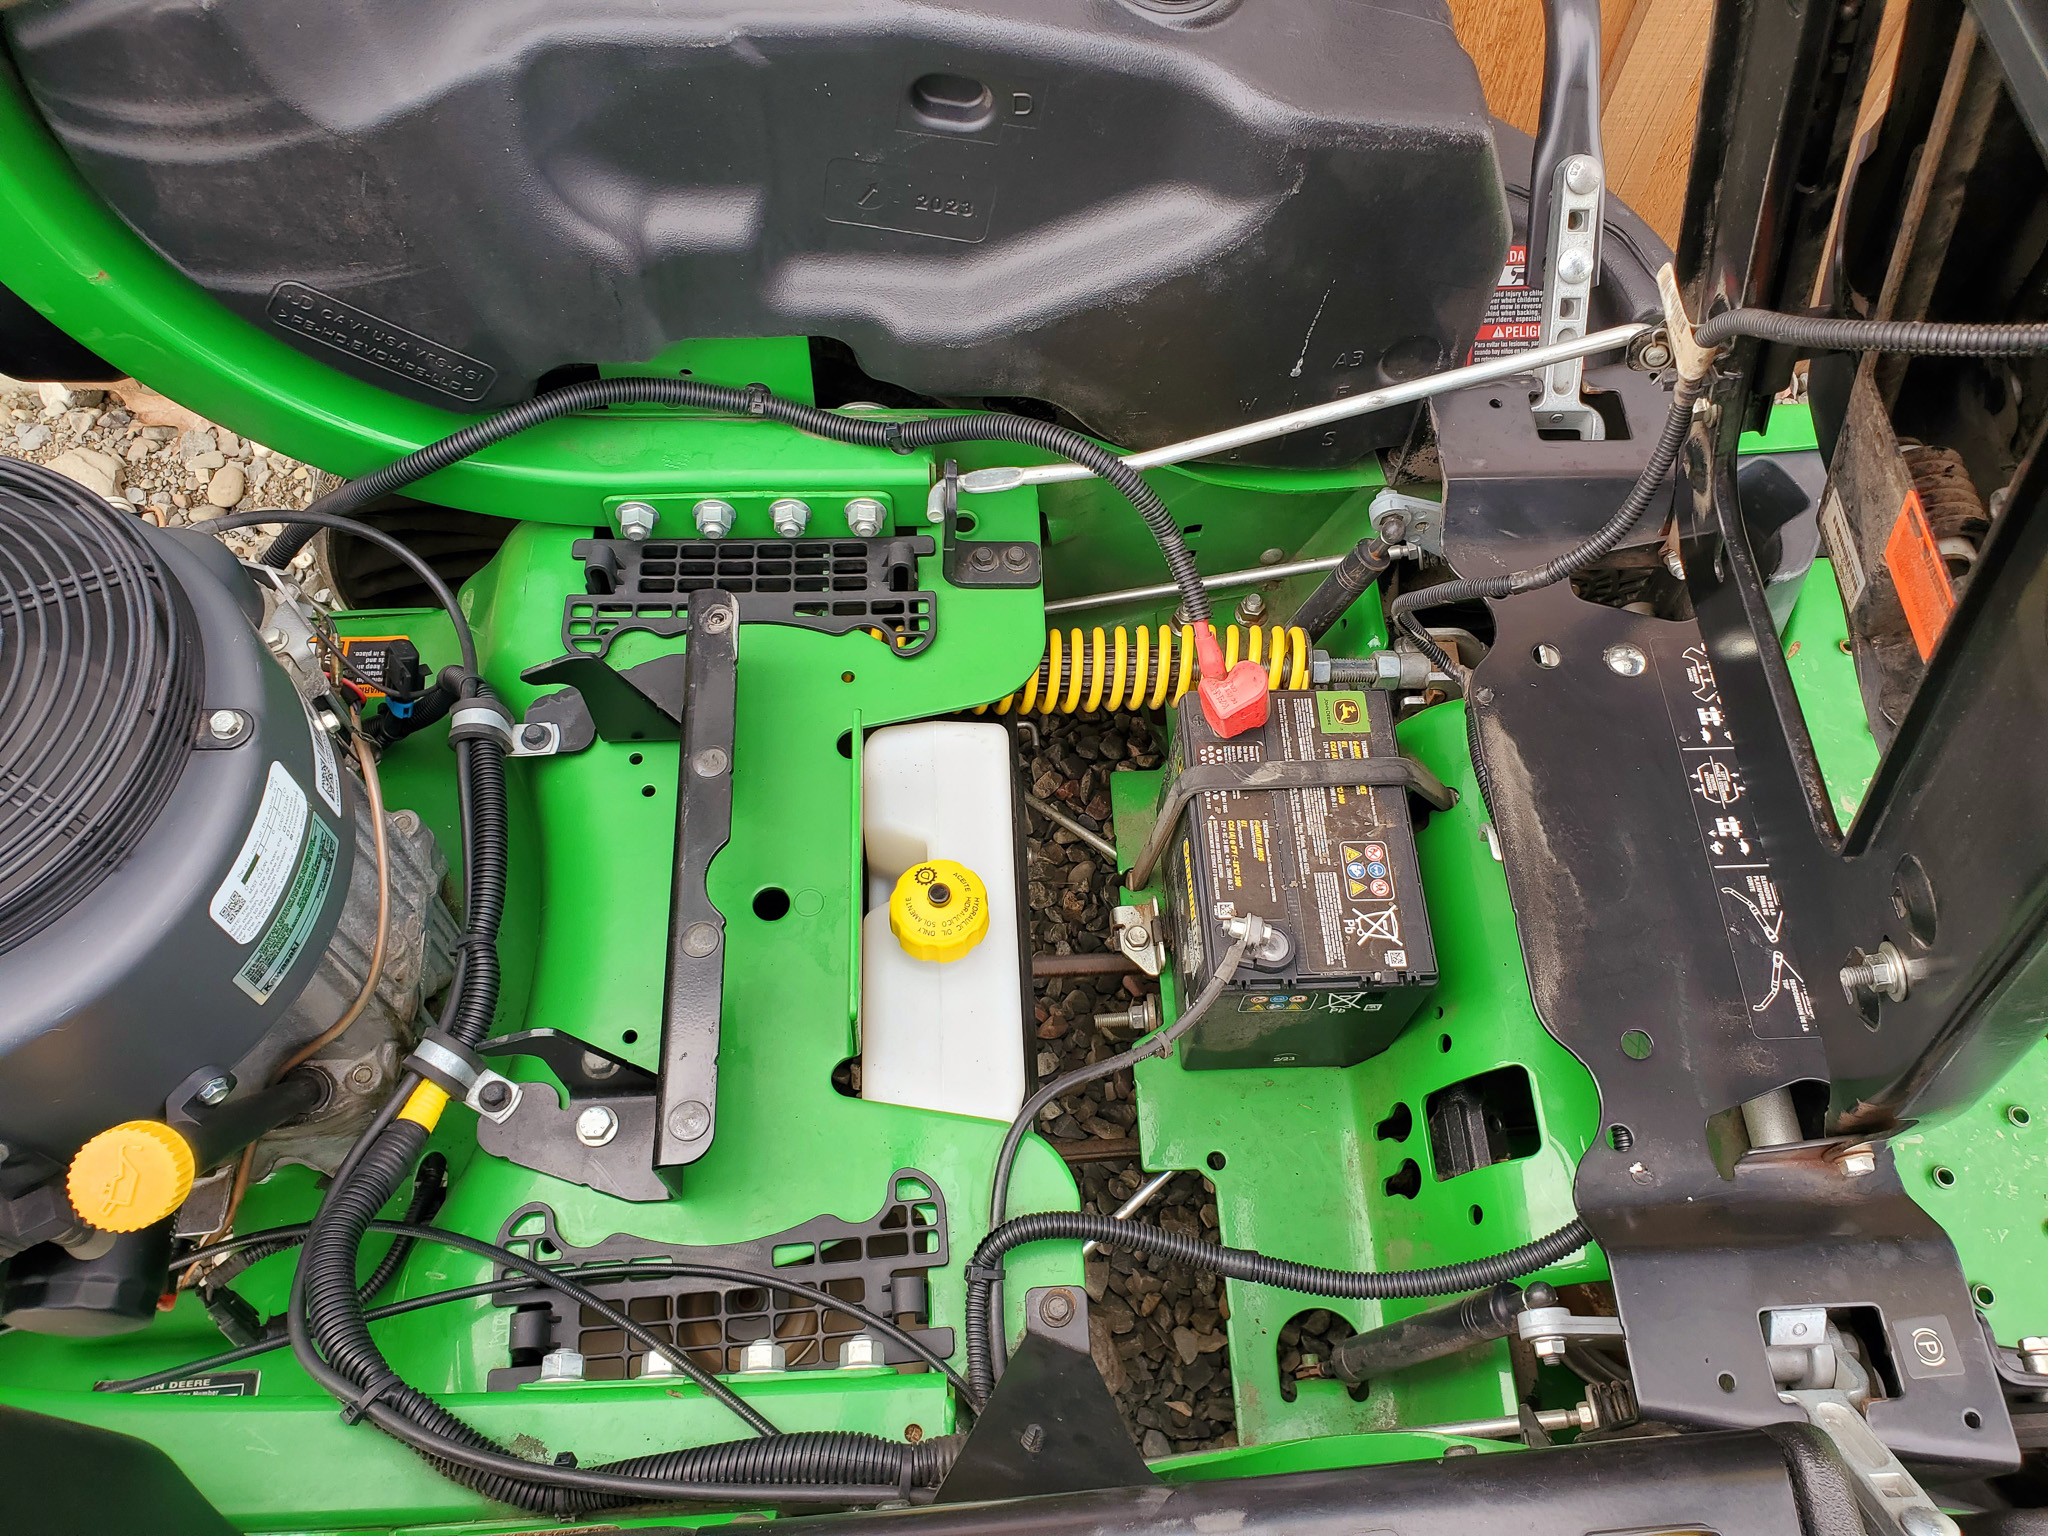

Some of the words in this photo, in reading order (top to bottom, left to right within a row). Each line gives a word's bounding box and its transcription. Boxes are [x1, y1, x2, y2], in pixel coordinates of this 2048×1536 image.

[915, 194, 974, 217] 2023
[1506, 326, 1540, 338] PELIG
[953, 872, 971, 891] ACEITE
[955, 897, 979, 931] HYDRAULIC
[917, 927, 935, 936] ONLY
[1343, 919, 1355, 933] Pb
[168, 1378, 211, 1389] DEERE
